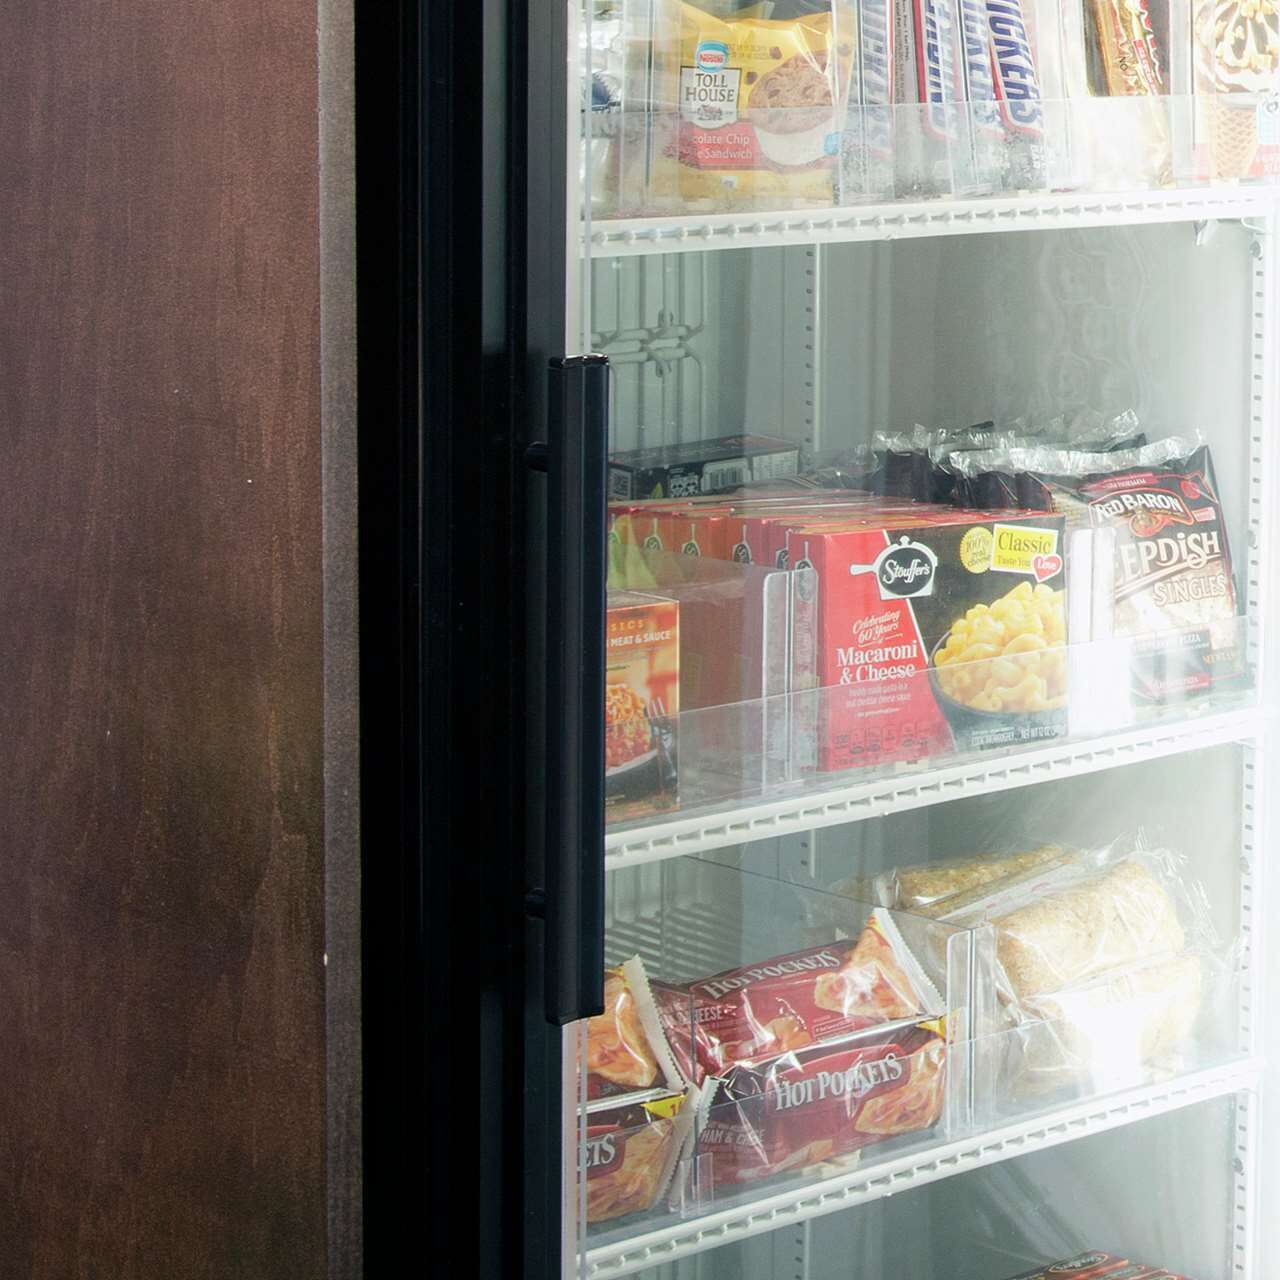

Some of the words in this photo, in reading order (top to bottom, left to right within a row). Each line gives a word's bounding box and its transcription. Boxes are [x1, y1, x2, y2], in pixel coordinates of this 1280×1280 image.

[695, 73, 728, 88] TOLL
[685, 86, 735, 102] HOUSE
[726, 133, 750, 147] Chip
[1096, 500, 1124, 520] RED
[1125, 493, 1184, 514] BARON
[998, 531, 1052, 554] Classic
[881, 559, 931, 585] Stouffer's
[1153, 572, 1228, 606] SINGLES
[610, 635, 634, 648] MEAT
[643, 630, 672, 643] SAUCE
[836, 639, 918, 667] Macaroni
[840, 666, 854, 685] &
[855, 663, 916, 682] Cheese
